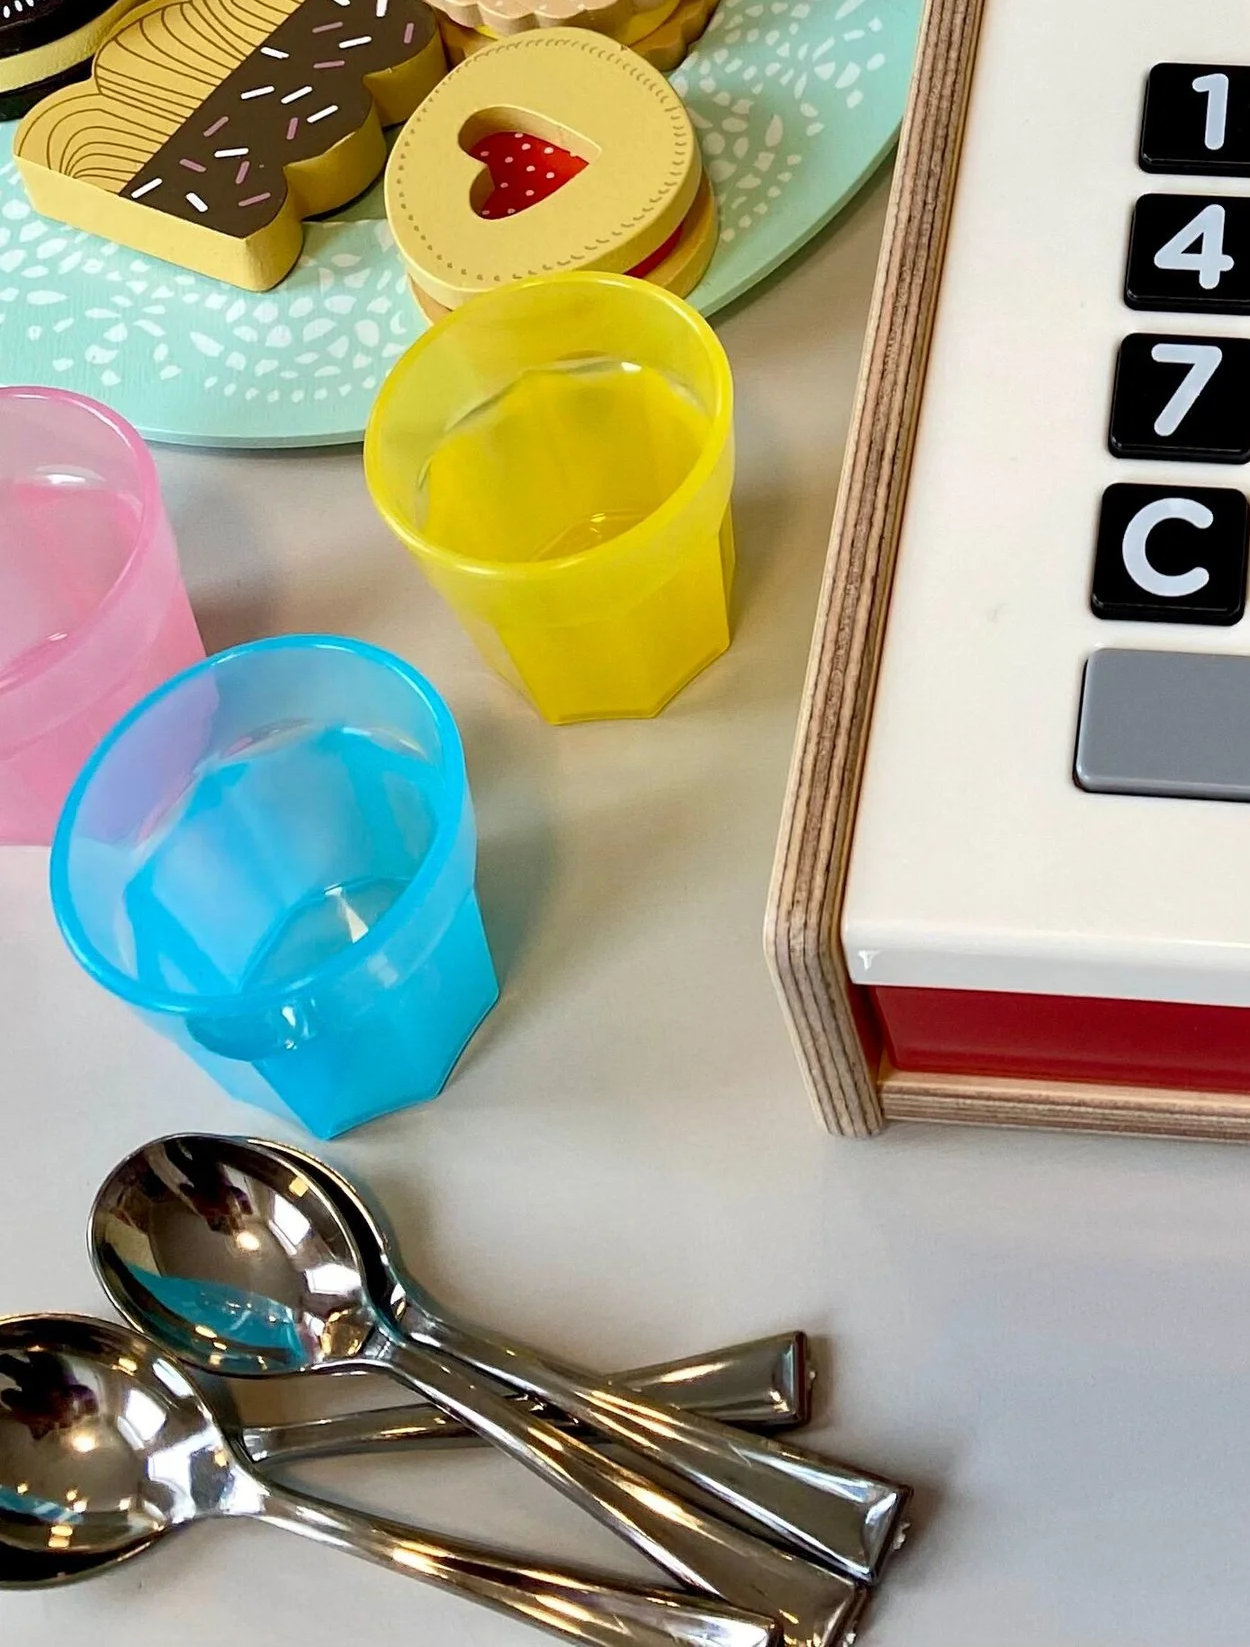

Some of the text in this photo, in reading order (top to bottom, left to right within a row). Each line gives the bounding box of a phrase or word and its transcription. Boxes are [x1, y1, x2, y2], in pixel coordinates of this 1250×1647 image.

[1192, 73, 1229, 151] 1
[1153, 204, 1235, 290] 4
[1151, 343, 1223, 437] 7
[1122, 497, 1214, 597] C
